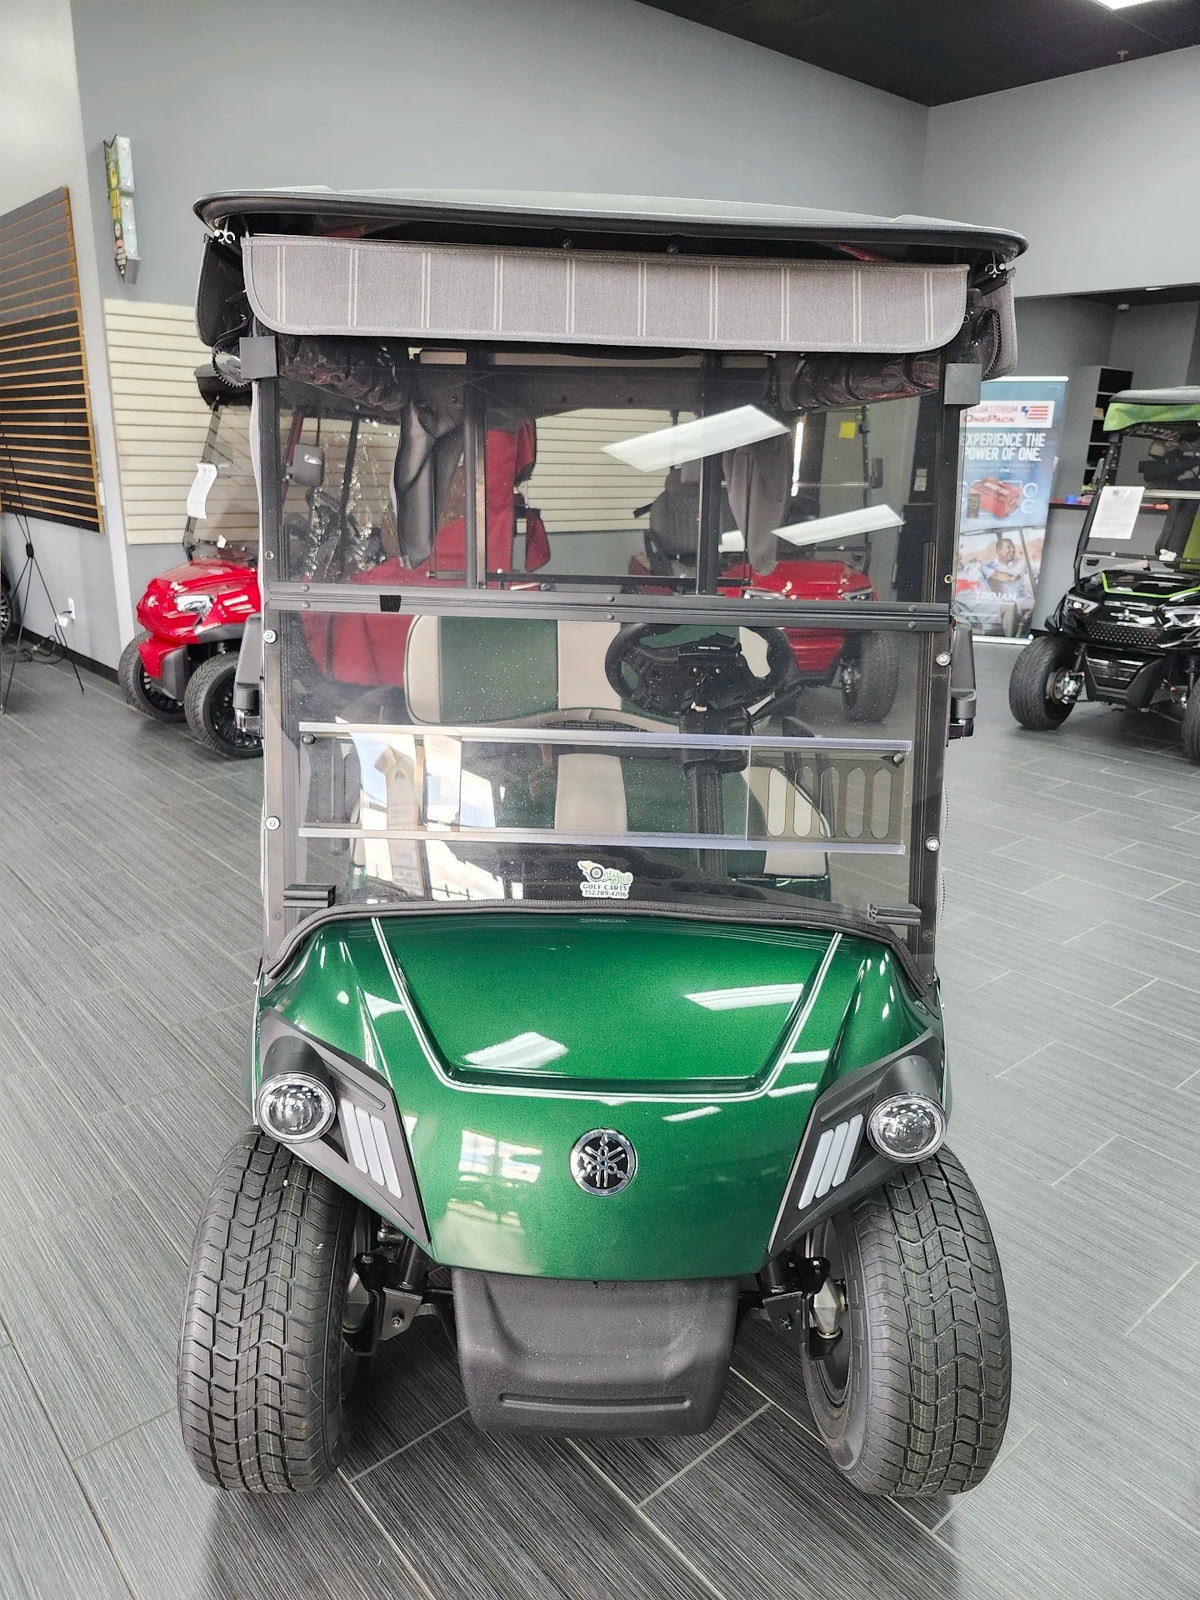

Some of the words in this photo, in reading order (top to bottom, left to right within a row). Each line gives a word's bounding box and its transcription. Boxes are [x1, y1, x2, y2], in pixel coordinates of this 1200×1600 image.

[1025, 432, 1047, 448] THE
[962, 446, 999, 461] POWER
[1001, 447, 1017, 461] OF
[975, 591, 1017, 601] TROJAN
